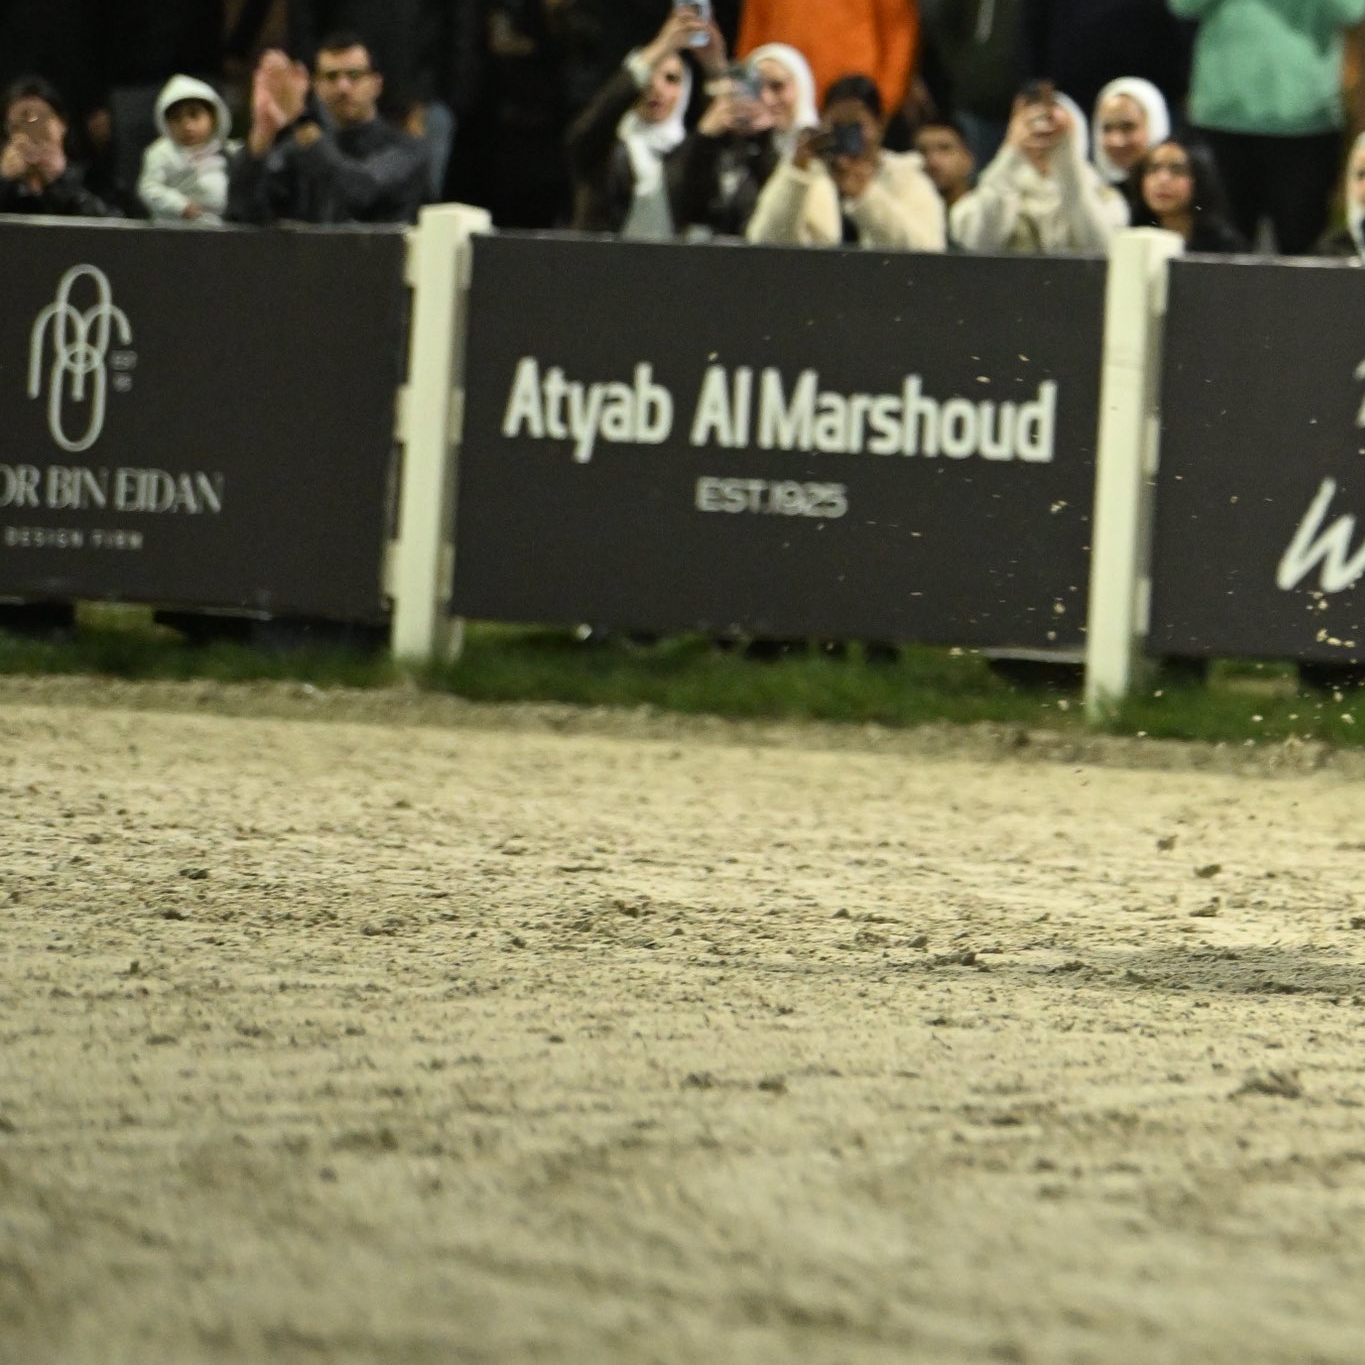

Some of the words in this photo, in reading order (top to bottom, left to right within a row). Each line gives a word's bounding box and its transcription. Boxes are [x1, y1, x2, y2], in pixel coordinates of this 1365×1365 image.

[504, 357, 673, 463] Atyab
[690, 365, 753, 448] Al
[758, 368, 1058, 463] Marshoud
[46, 465, 109, 510] BIN
[114, 467, 224, 515] EIDAN
